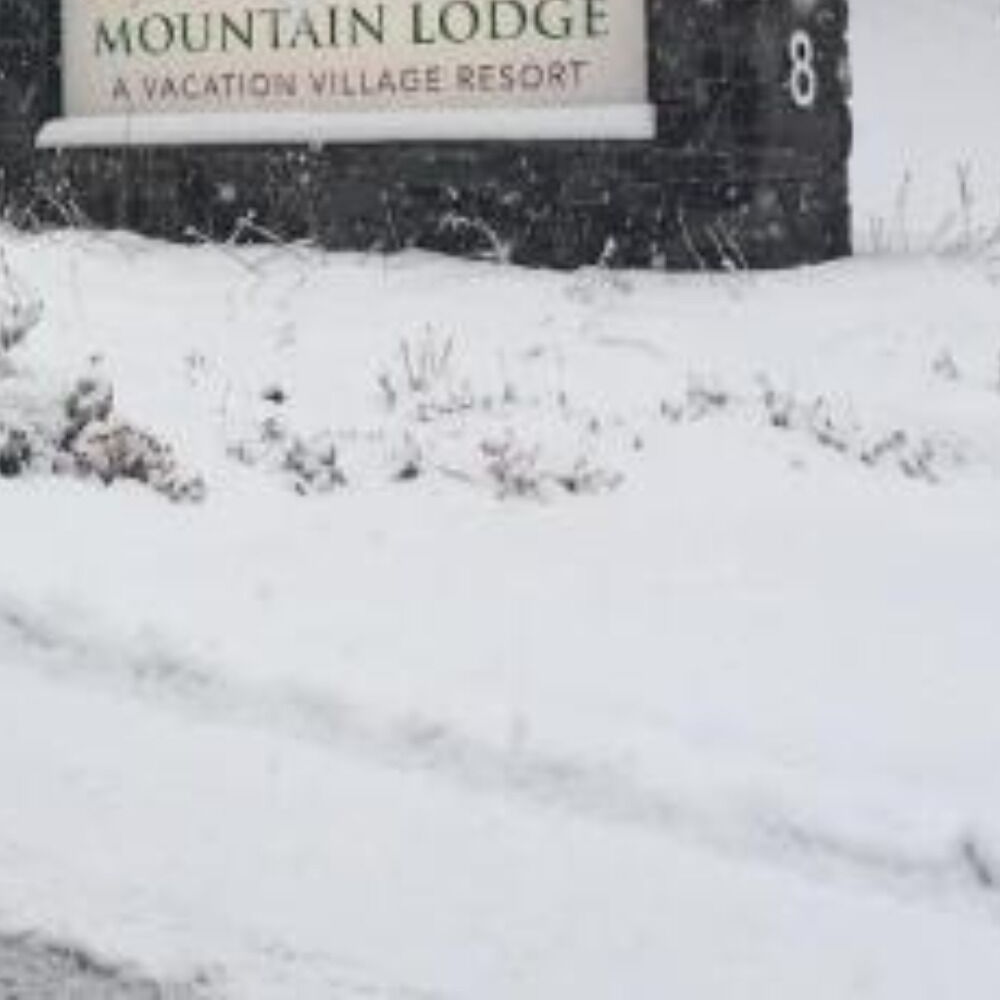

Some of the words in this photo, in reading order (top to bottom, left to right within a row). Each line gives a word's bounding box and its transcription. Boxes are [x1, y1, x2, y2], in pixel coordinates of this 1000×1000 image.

[96, 3, 386, 56] MOUNTAIN
[112, 76, 132, 100] A
[143, 70, 297, 99] VACATION
[309, 64, 441, 96] VILLAGE
[456, 60, 589, 92] RESORT
[790, 29, 816, 106] 8
